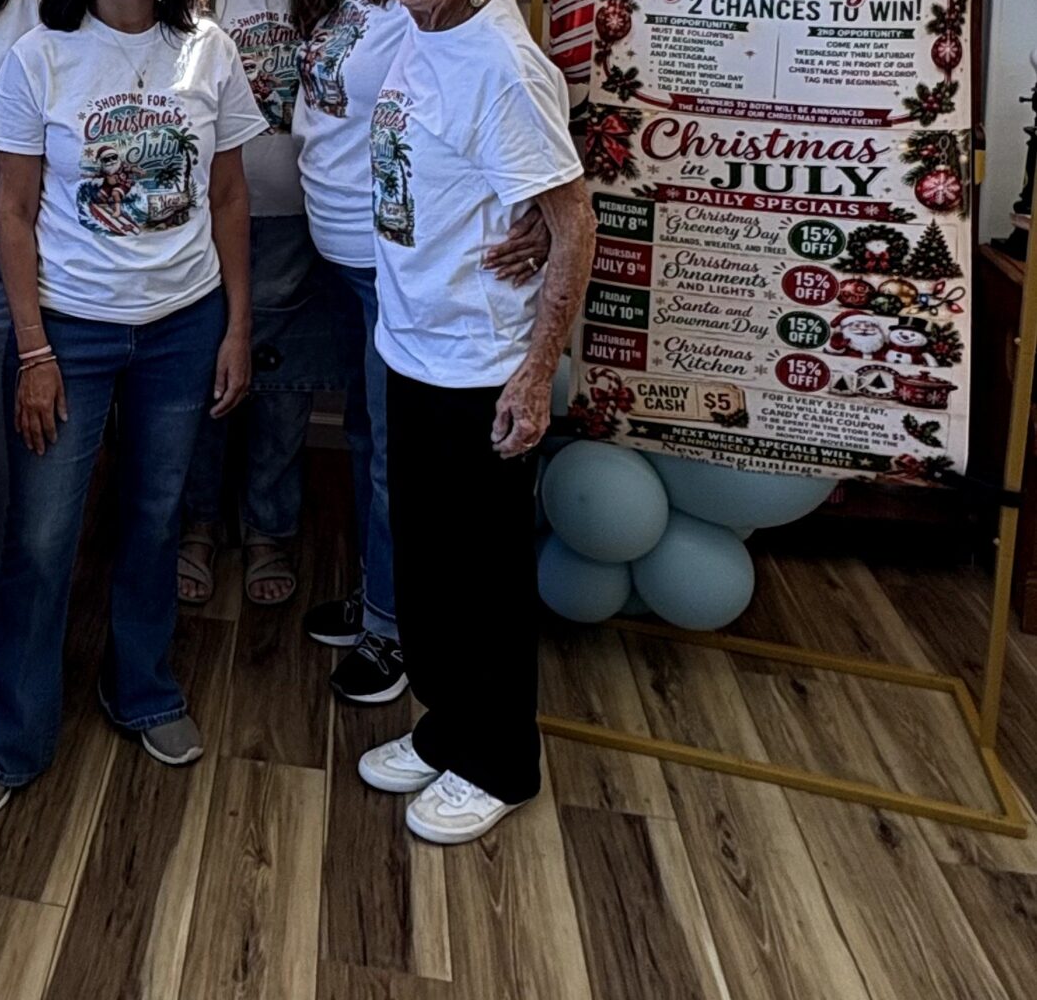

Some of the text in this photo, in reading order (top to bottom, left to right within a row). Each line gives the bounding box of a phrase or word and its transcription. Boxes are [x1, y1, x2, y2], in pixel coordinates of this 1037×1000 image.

[238, 12, 279, 27] SHOPPING
[829, 1, 859, 22] TO
[672, 36, 724, 46] BEGINNINGS
[687, 30, 734, 39] FOLLOWING
[665, 44, 705, 52] FACEBOOK
[796, 49, 848, 57] WEDNESDAY
[826, 41, 851, 49] COME
[263, 46, 297, 73] Jul
[698, 63, 718, 71] POST
[658, 68, 696, 77] COMMENT
[699, 72, 725, 80] WHICH
[789, 66, 839, 75] CHRISTMAS
[681, 86, 710, 94] PEOPLE
[95, 93, 167, 112] SHOPPING FOR
[84, 107, 186, 141] Christmas
[126, 131, 182, 165] July
[641, 117, 890, 164] Christmas
[680, 160, 888, 197] in JULY
[599, 200, 648, 216] WEDNESDAY
[685, 190, 860, 216] DAILY SPECIALS
[598, 212, 626, 229] JULY
[685, 206, 761, 227] Christmas
[666, 215, 780, 245] Greenery Day
[800, 226, 837, 243] 15%
[600, 245, 642, 260] THURSDAY
[745, 244, 761, 252] AND
[764, 247, 787, 255] TREES
[801, 242, 833, 255] OFF!
[593, 257, 624, 274] JULY
[675, 250, 761, 273] Christmas
[663, 262, 771, 288] Ornaments
[794, 272, 830, 289] 15%
[600, 290, 631, 303] FRIDAY
[677, 282, 755, 298] AND LIGHTS
[795, 288, 826, 301] OFF!
[588, 301, 617, 317] JULY
[668, 295, 754, 317] Santa and
[653, 308, 770, 340] Snowman Day
[787, 317, 822, 334] 15%
[592, 332, 636, 347] SATURDAY
[789, 332, 818, 345] OFF!
[587, 344, 616, 360] JULY
[664, 337, 755, 361] Christmas
[666, 353, 748, 376] Kitchen
[786, 359, 822, 377] 15%
[788, 374, 818, 387] OFF!
[637, 384, 690, 400] CANDY
[762, 392, 784, 401] FOR
[787, 395, 823, 407] EVERY
[644, 397, 685, 412] CASH
[703, 392, 731, 410] $5
[761, 408, 885, 431] CANDY CASH COUPON
[796, 405, 819, 414] WILL
[821, 409, 860, 420] RECEIVE
[672, 427, 853, 460] NEXT WEEK'S SPECIALS WILL
[679, 436, 751, 453] ANNOUNCED
[754, 447, 767, 455] AT
[782, 451, 819, 463] LATER
[663, 442, 703, 457] New
[712, 451, 822, 475] Beginnings
